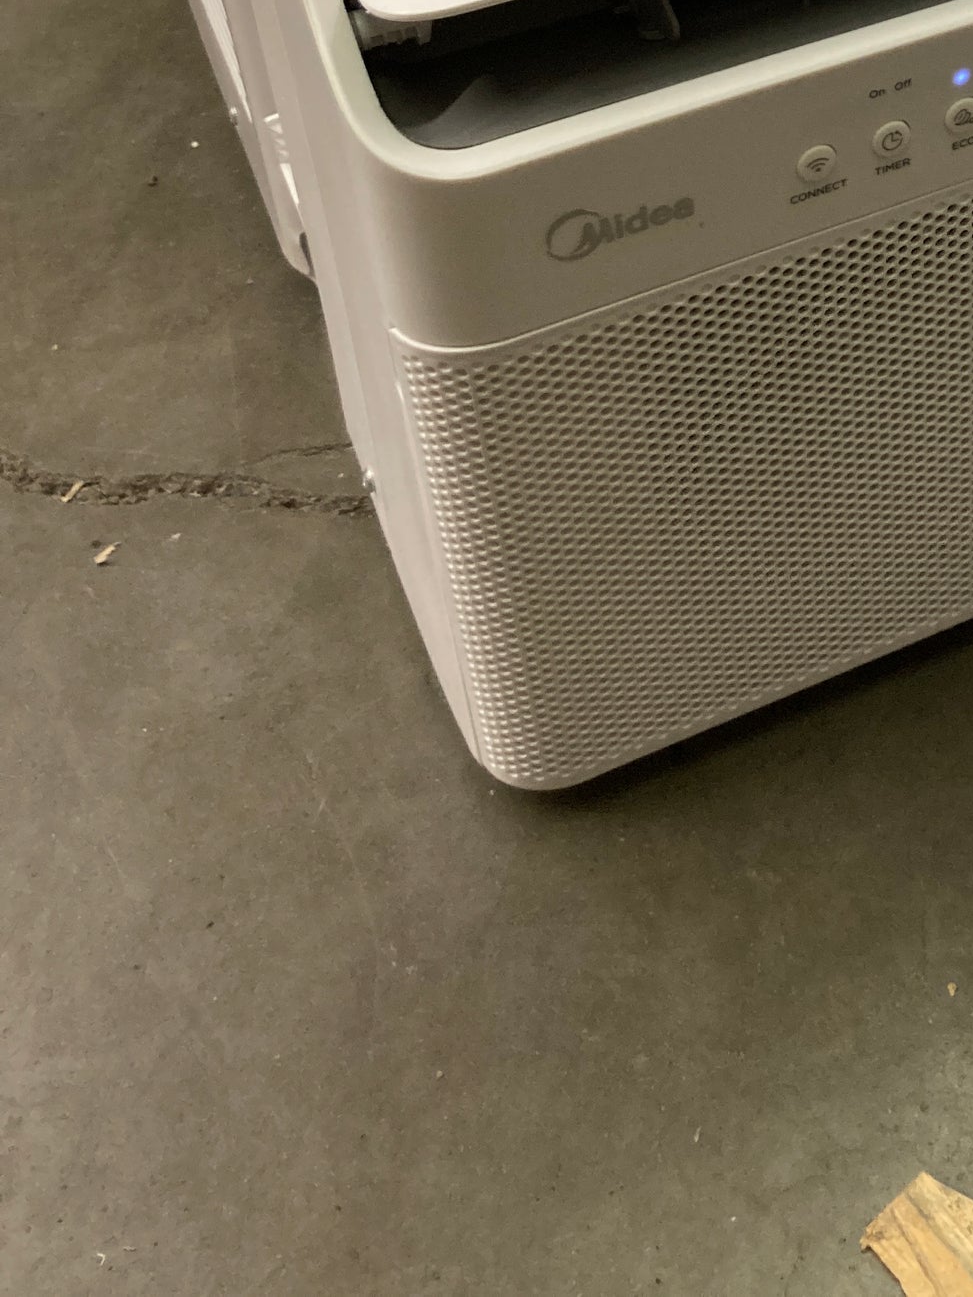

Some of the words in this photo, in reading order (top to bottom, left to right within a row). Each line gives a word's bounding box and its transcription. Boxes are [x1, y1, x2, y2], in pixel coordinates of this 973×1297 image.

[869, 88, 886, 99] On
[894, 78, 912, 91] Off
[875, 157, 912, 176] TIMER
[790, 178, 848, 204] CONNECT
[545, 197, 696, 262] Midea
